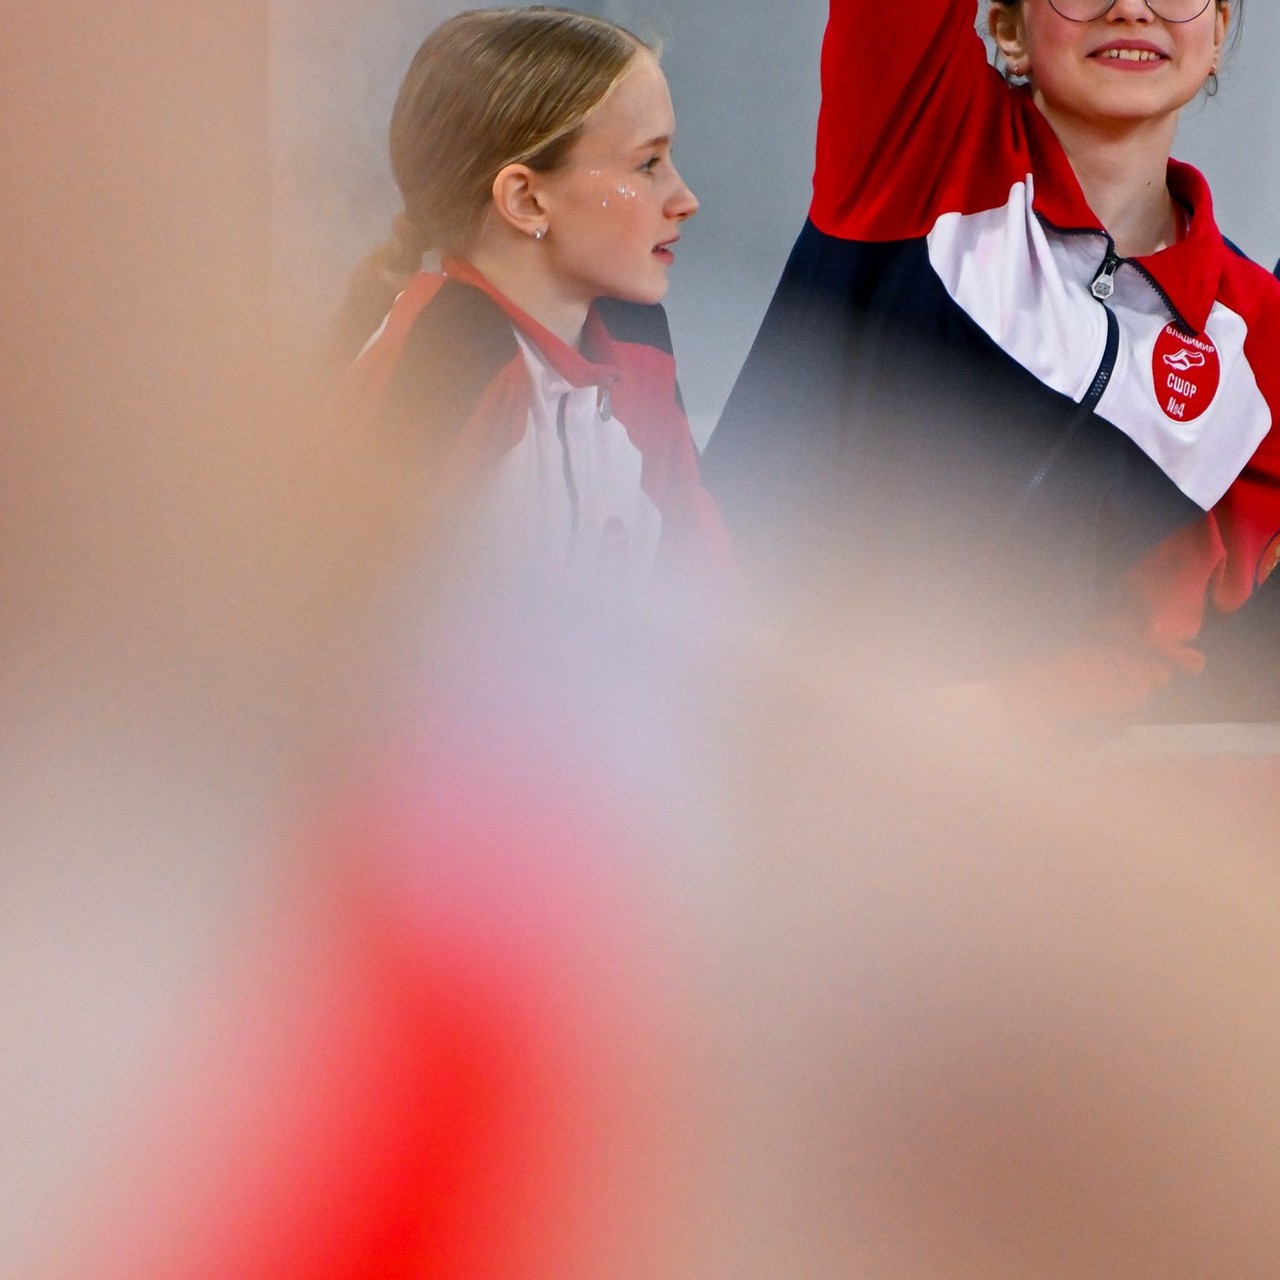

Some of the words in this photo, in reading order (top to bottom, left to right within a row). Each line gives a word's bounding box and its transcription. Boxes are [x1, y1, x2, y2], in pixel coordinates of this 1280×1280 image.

[1165, 324, 1216, 354] ВЛАДИМИР
[1166, 372, 1198, 398] СШОР
[1166, 396, 1186, 419] №4
